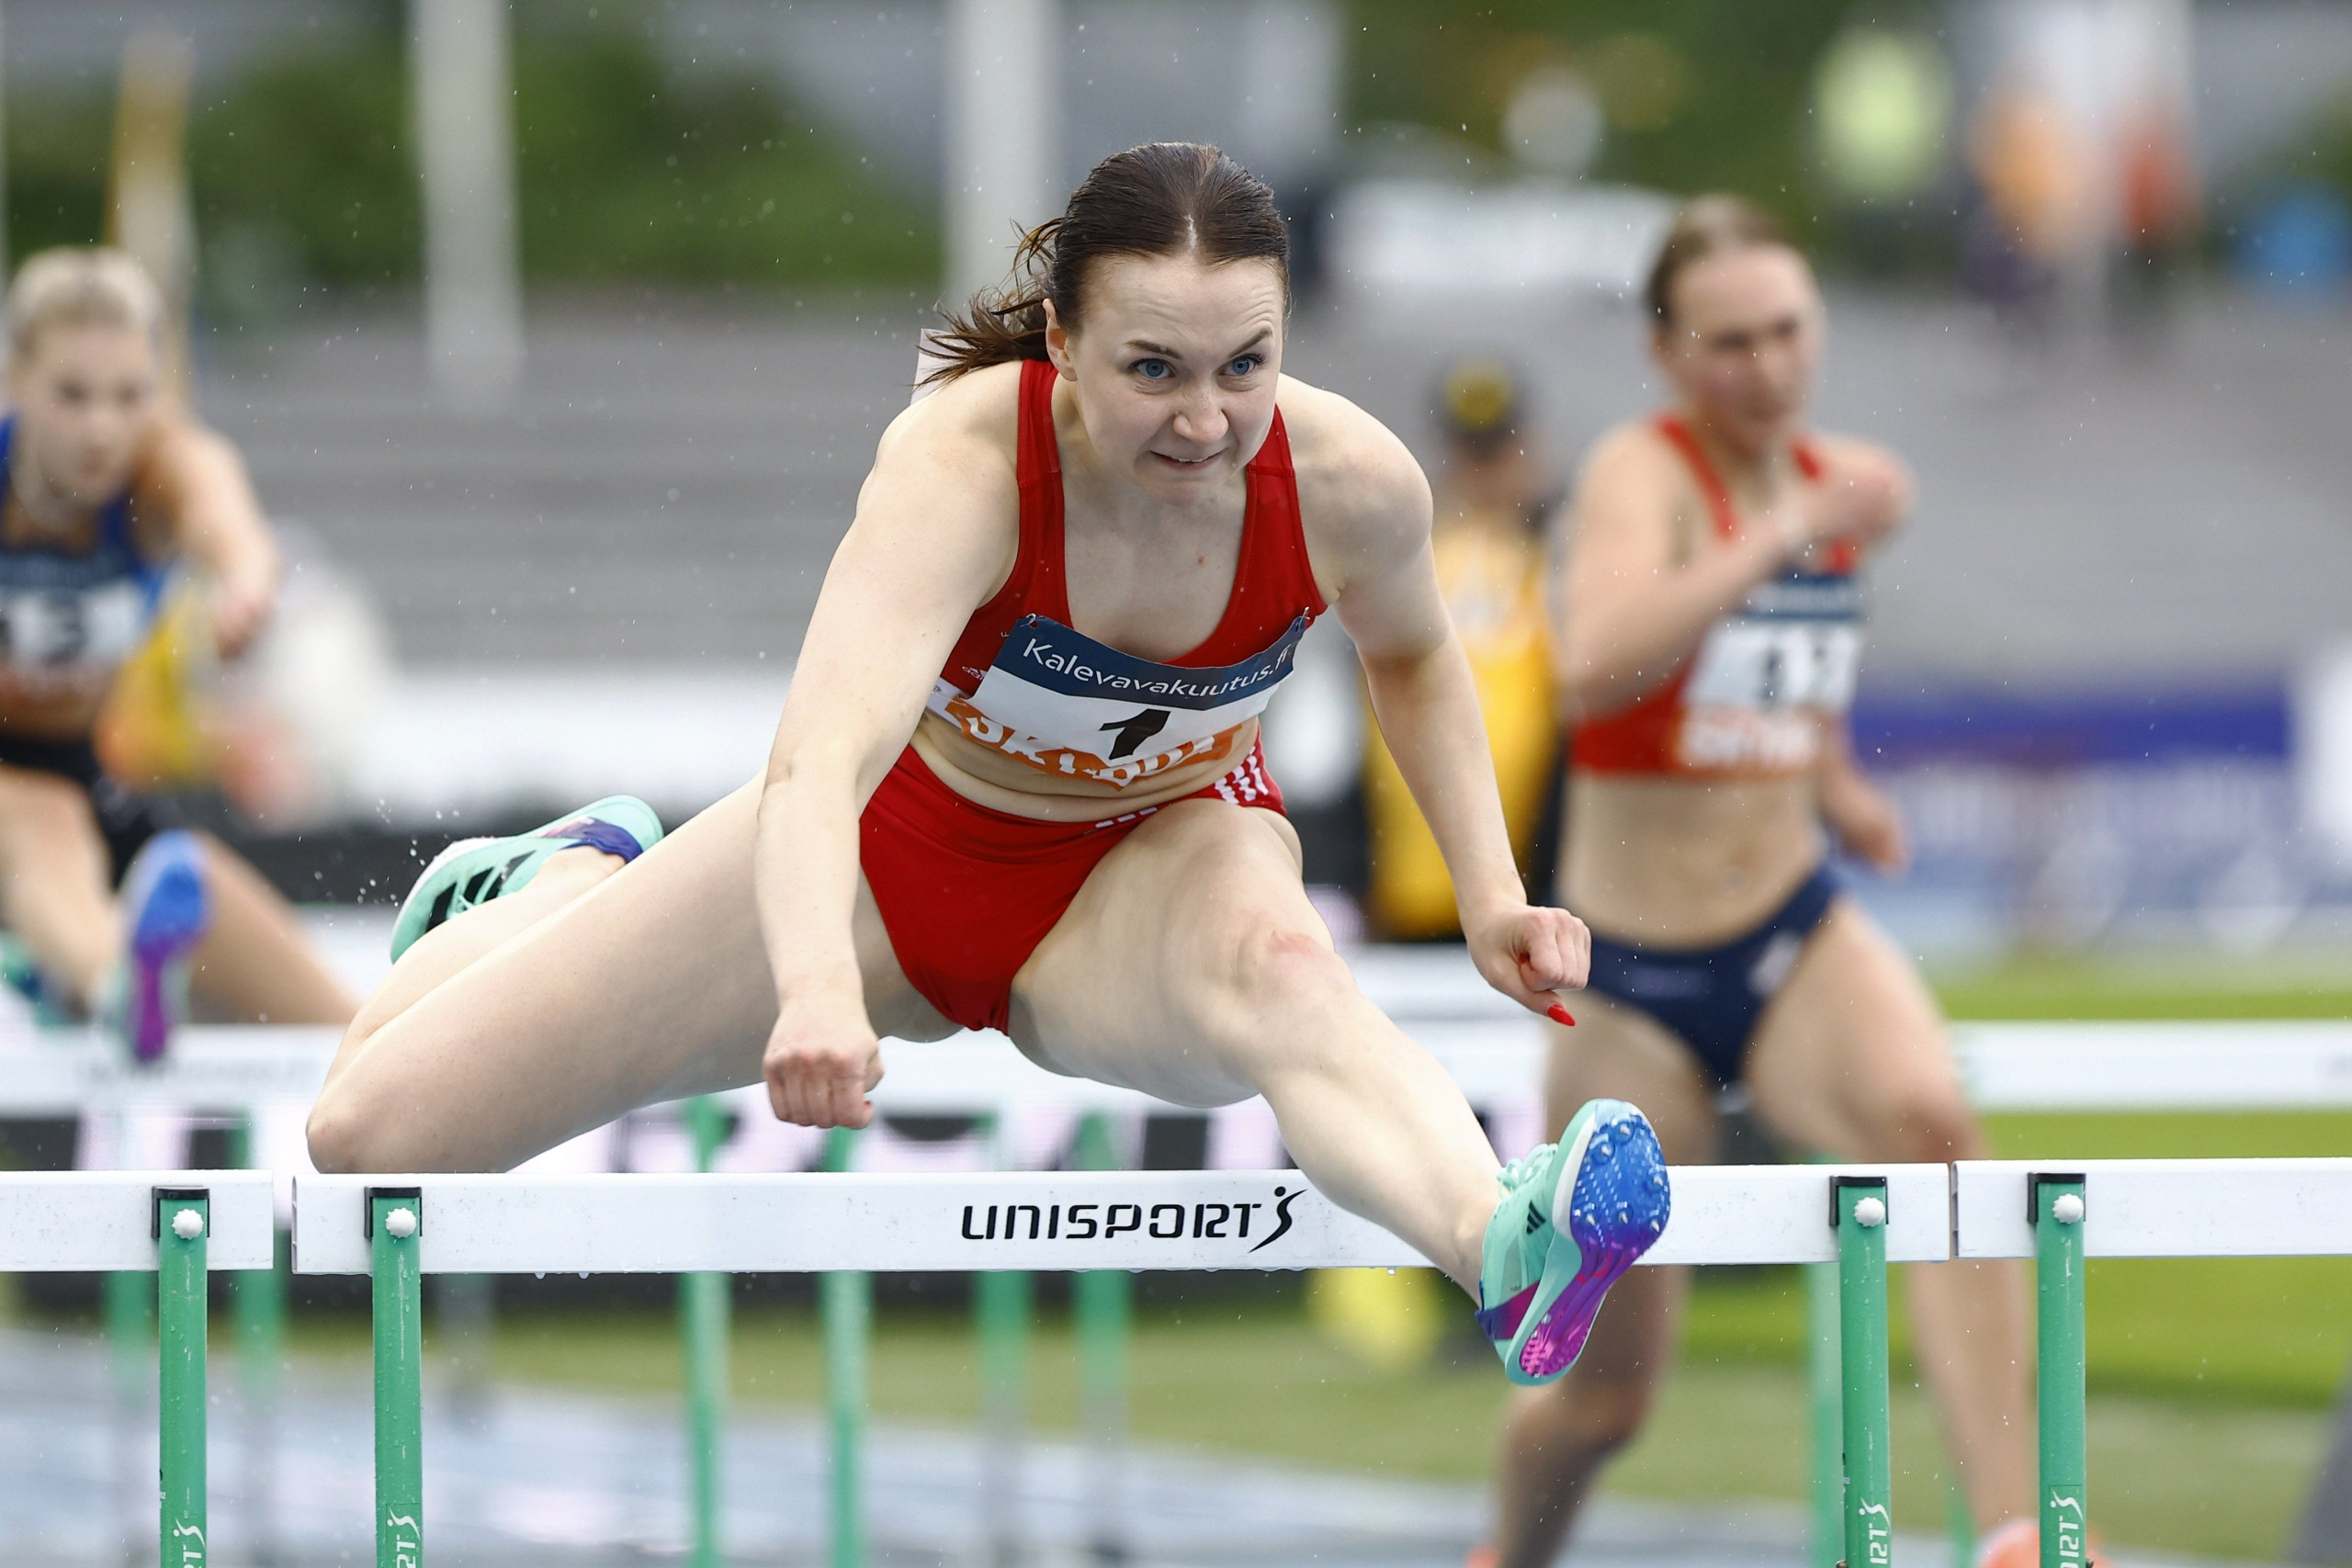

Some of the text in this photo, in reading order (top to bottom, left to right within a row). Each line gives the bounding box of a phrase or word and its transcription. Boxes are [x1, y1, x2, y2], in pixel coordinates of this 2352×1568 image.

[1021, 637, 1292, 697] Kalevavakuutus.fi
[1098, 708, 1171, 761] 1
[961, 1202, 1262, 1240] UNISPORT
[2058, 1515, 2080, 1568] RT
